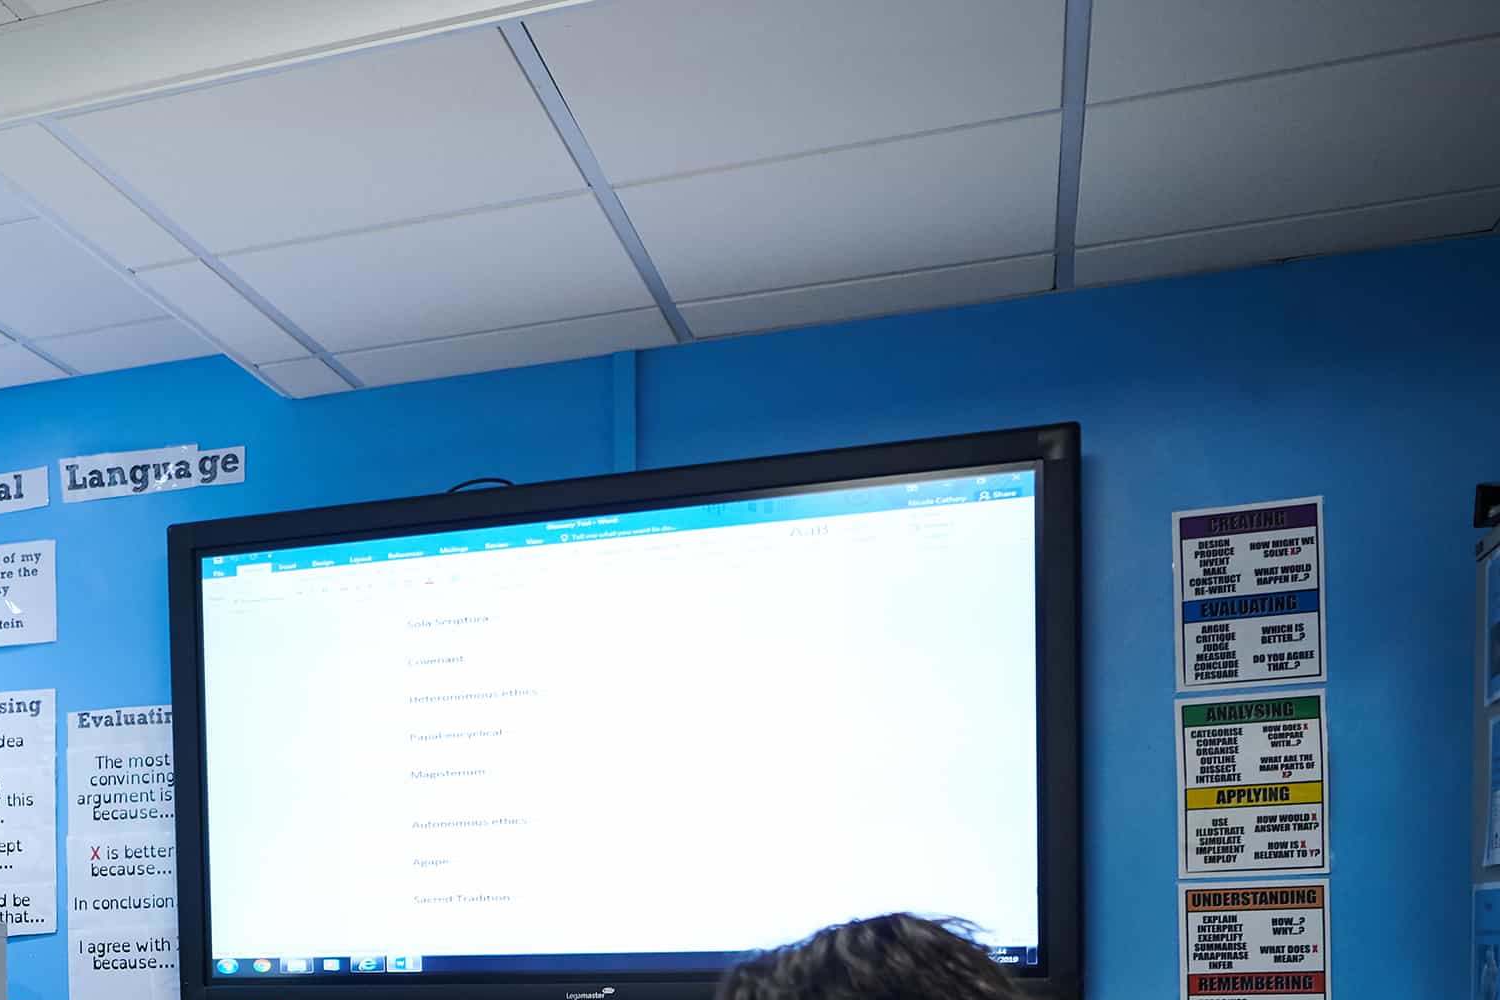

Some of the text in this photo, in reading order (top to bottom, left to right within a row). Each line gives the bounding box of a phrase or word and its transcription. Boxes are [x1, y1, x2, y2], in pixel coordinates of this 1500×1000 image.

[66, 451, 240, 492] Language
[1210, 511, 1285, 531] CREATING
[1199, 539, 1229, 549] DESIGN
[1250, 537, 1315, 550] HOW MIGHT WE
[3, 553, 15, 563] of
[21, 553, 41, 563] my
[1195, 548, 1234, 558] PRODUCE
[1264, 549, 1288, 557] SOLVE
[1200, 557, 1229, 567] INVENT
[18, 568, 37, 577] the
[1204, 567, 1226, 576] MAKE
[1190, 574, 1241, 587] CONSTRUCT
[1195, 584, 1236, 596] RE-WRITE
[1201, 595, 1296, 616] EVALUATING
[1202, 624, 1229, 634] ARGUE
[1196, 633, 1236, 643] CRITIQUE
[1204, 642, 1229, 652] JUDGE
[1196, 651, 1236, 662] MEASURE
[1194, 660, 1238, 671] CONCLUDE
[1195, 670, 1238, 680] PERSUADE
[1206, 702, 1293, 721] ANALYSING
[1191, 728, 1242, 738] CATEGORISE
[1196, 737, 1237, 746] COMPARE
[1196, 746, 1239, 756] ORGANISE
[95, 753, 170, 768] The most
[1200, 756, 1236, 765] OUTLINE
[1200, 764, 1236, 774] DISSECT
[91, 770, 175, 787] convincing
[1196, 774, 1241, 783] INTEGRATE
[8, 793, 33, 806] this
[77, 788, 172, 807] argument is
[1217, 787, 1290, 804] APPLYING
[93, 807, 174, 820] because...
[1279, 814, 1309, 822] WOULD
[1212, 818, 1228, 826] USE
[1255, 822, 1319, 832] ANSWER THAT?
[1196, 827, 1244, 836] ILLUSTRATE
[1200, 836, 1241, 845] SIMULATE
[91, 845, 173, 860] X is better
[1196, 845, 1244, 854] IMPLEMENT
[1204, 854, 1237, 863] EMPLOY
[91, 864, 172, 877] because...
[13, 894, 30, 906] be
[1192, 890, 1316, 907] UNDERSTANDING
[75, 898, 87, 910] In
[0, 910, 44, 923] that...
[1203, 915, 1237, 923] EXPLAIN
[1198, 924, 1242, 933] INTERPRET
[1198, 934, 1242, 942] EXEMPLIFY
[79, 938, 170, 957] I agree with
[1195, 942, 1246, 951] SUMMARISE
[1193, 952, 1249, 960] PARAPHRASE
[1274, 954, 1304, 963] MEAN?
[93, 958, 174, 969] because...
[1209, 961, 1232, 969] INFER
[1199, 976, 1313, 992] REMEMBERING
[566, 992, 604, 1000] Legamaster
